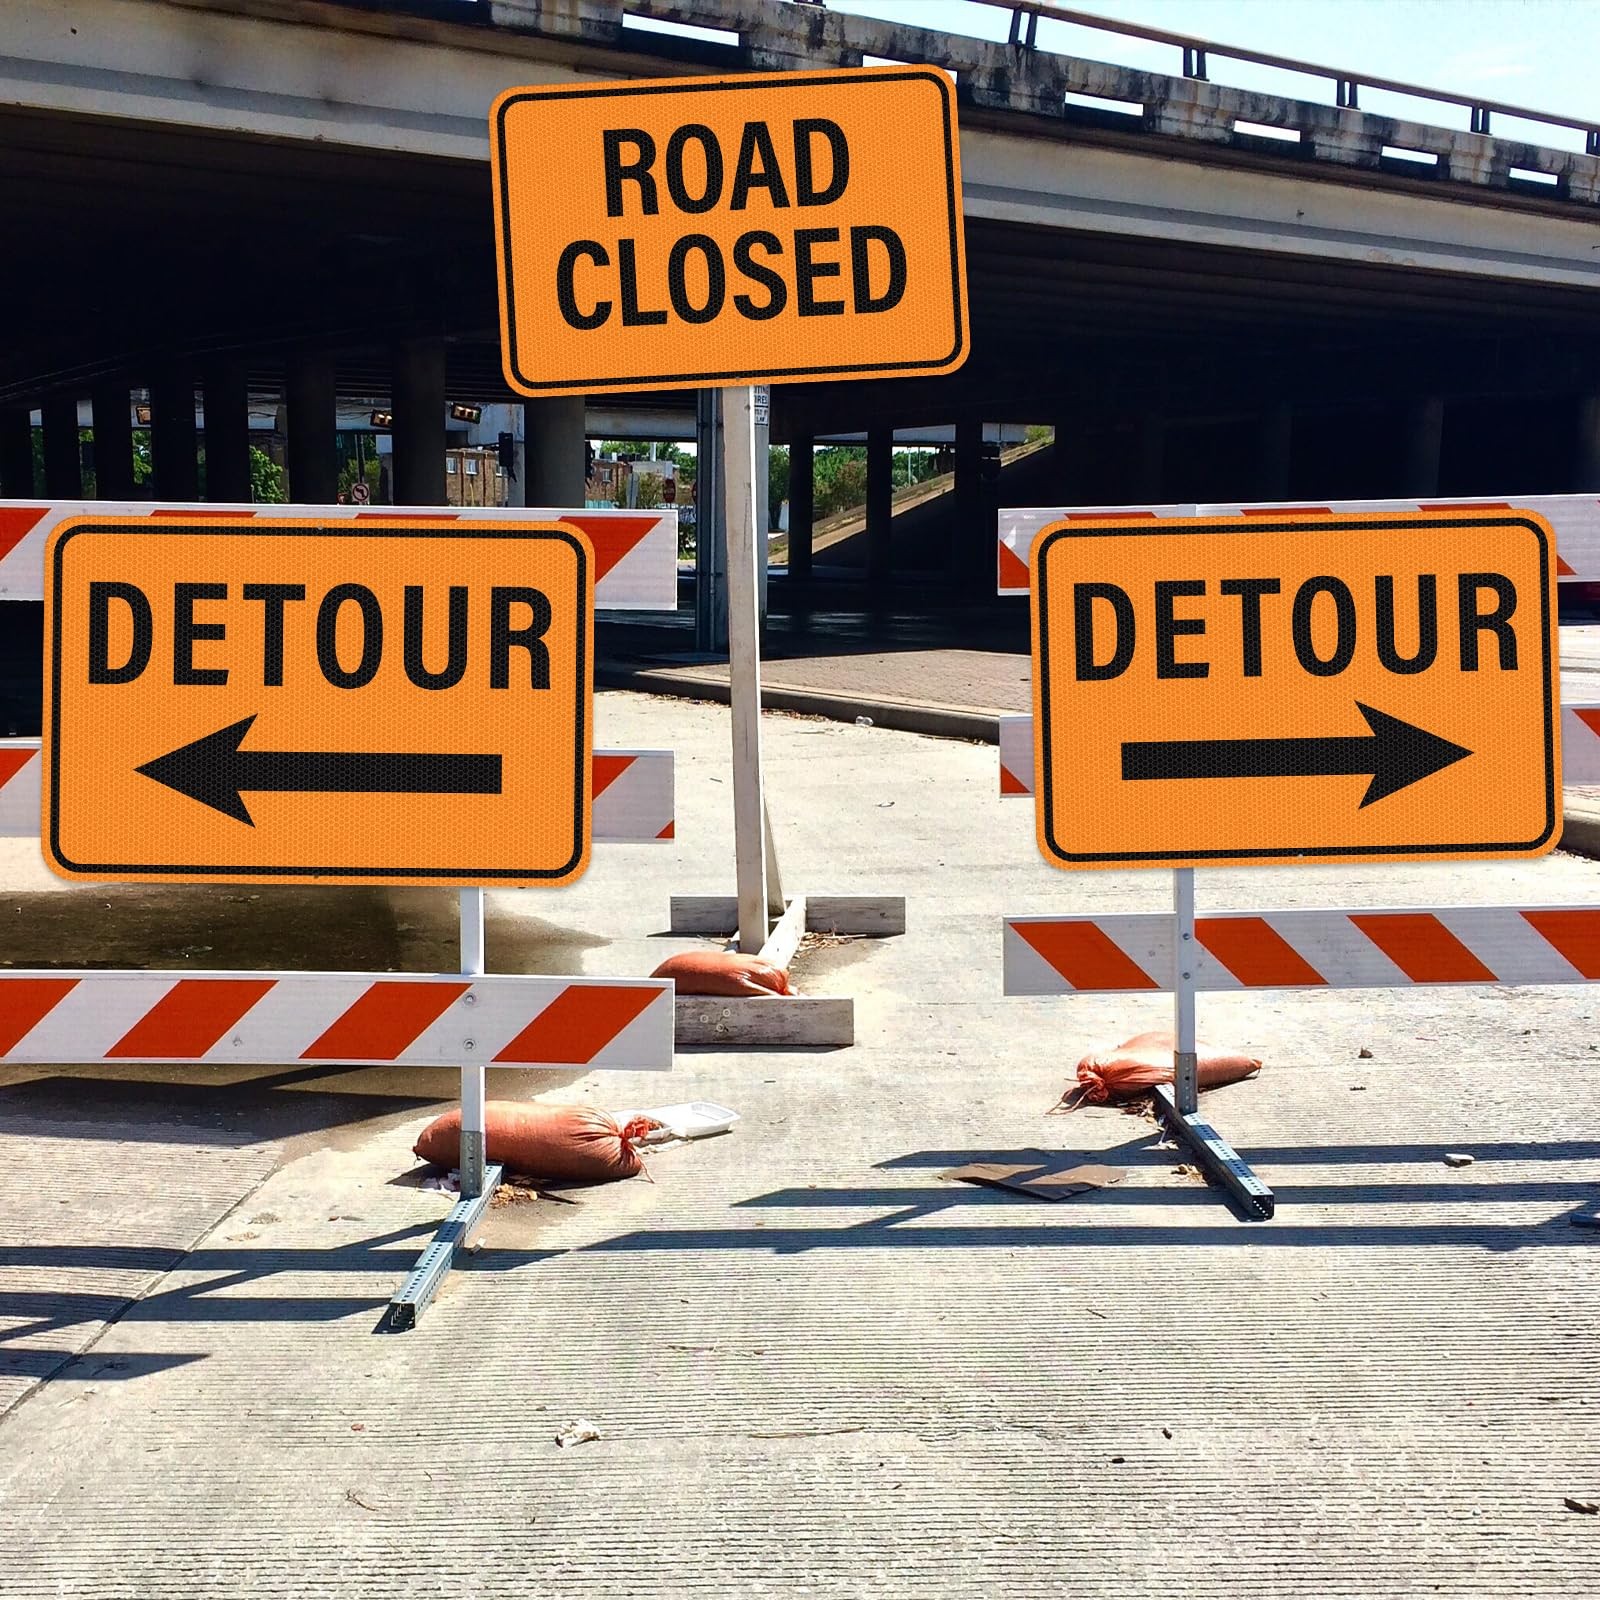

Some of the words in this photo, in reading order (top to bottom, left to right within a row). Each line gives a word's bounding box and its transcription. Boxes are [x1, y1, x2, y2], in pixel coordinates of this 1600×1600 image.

[603, 118, 849, 217] ROAD
[557, 225, 907, 330] CLOSED
[89, 582, 551, 690] DETOUR
[1074, 573, 1518, 681] DETOUR
